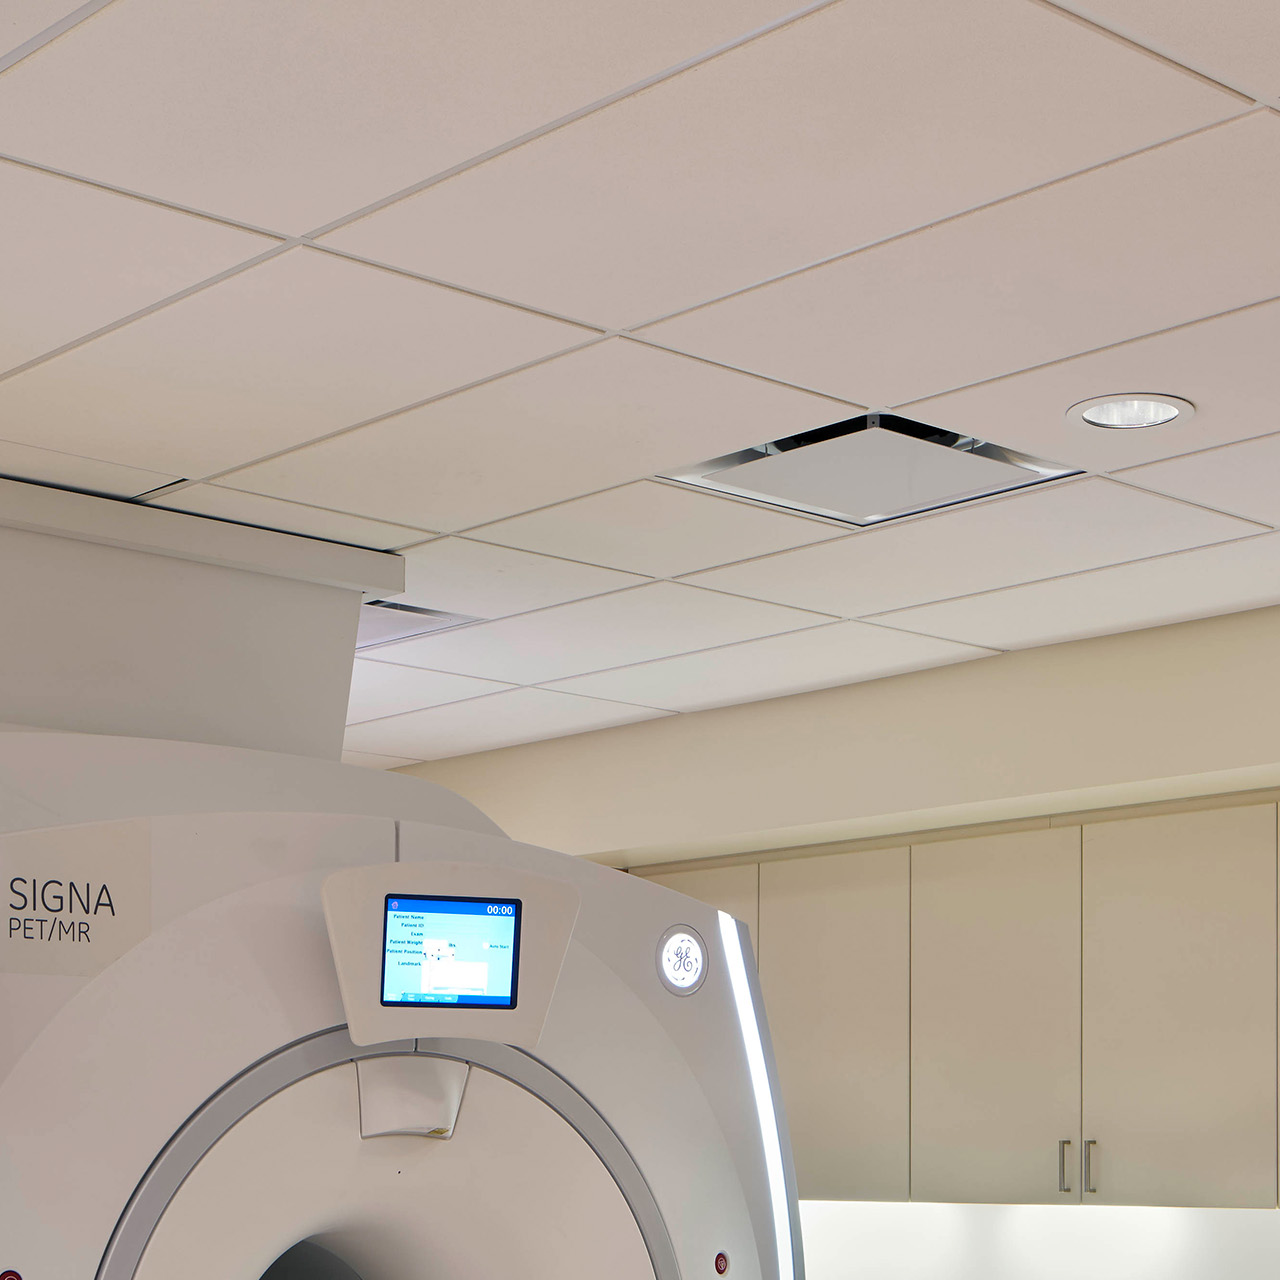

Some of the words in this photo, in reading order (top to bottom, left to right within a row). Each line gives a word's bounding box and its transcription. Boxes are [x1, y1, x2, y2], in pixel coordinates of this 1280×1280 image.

[9, 876, 116, 917] SIGNA
[487, 905, 514, 915] 00:00
[9, 916, 91, 943] PET/MR
